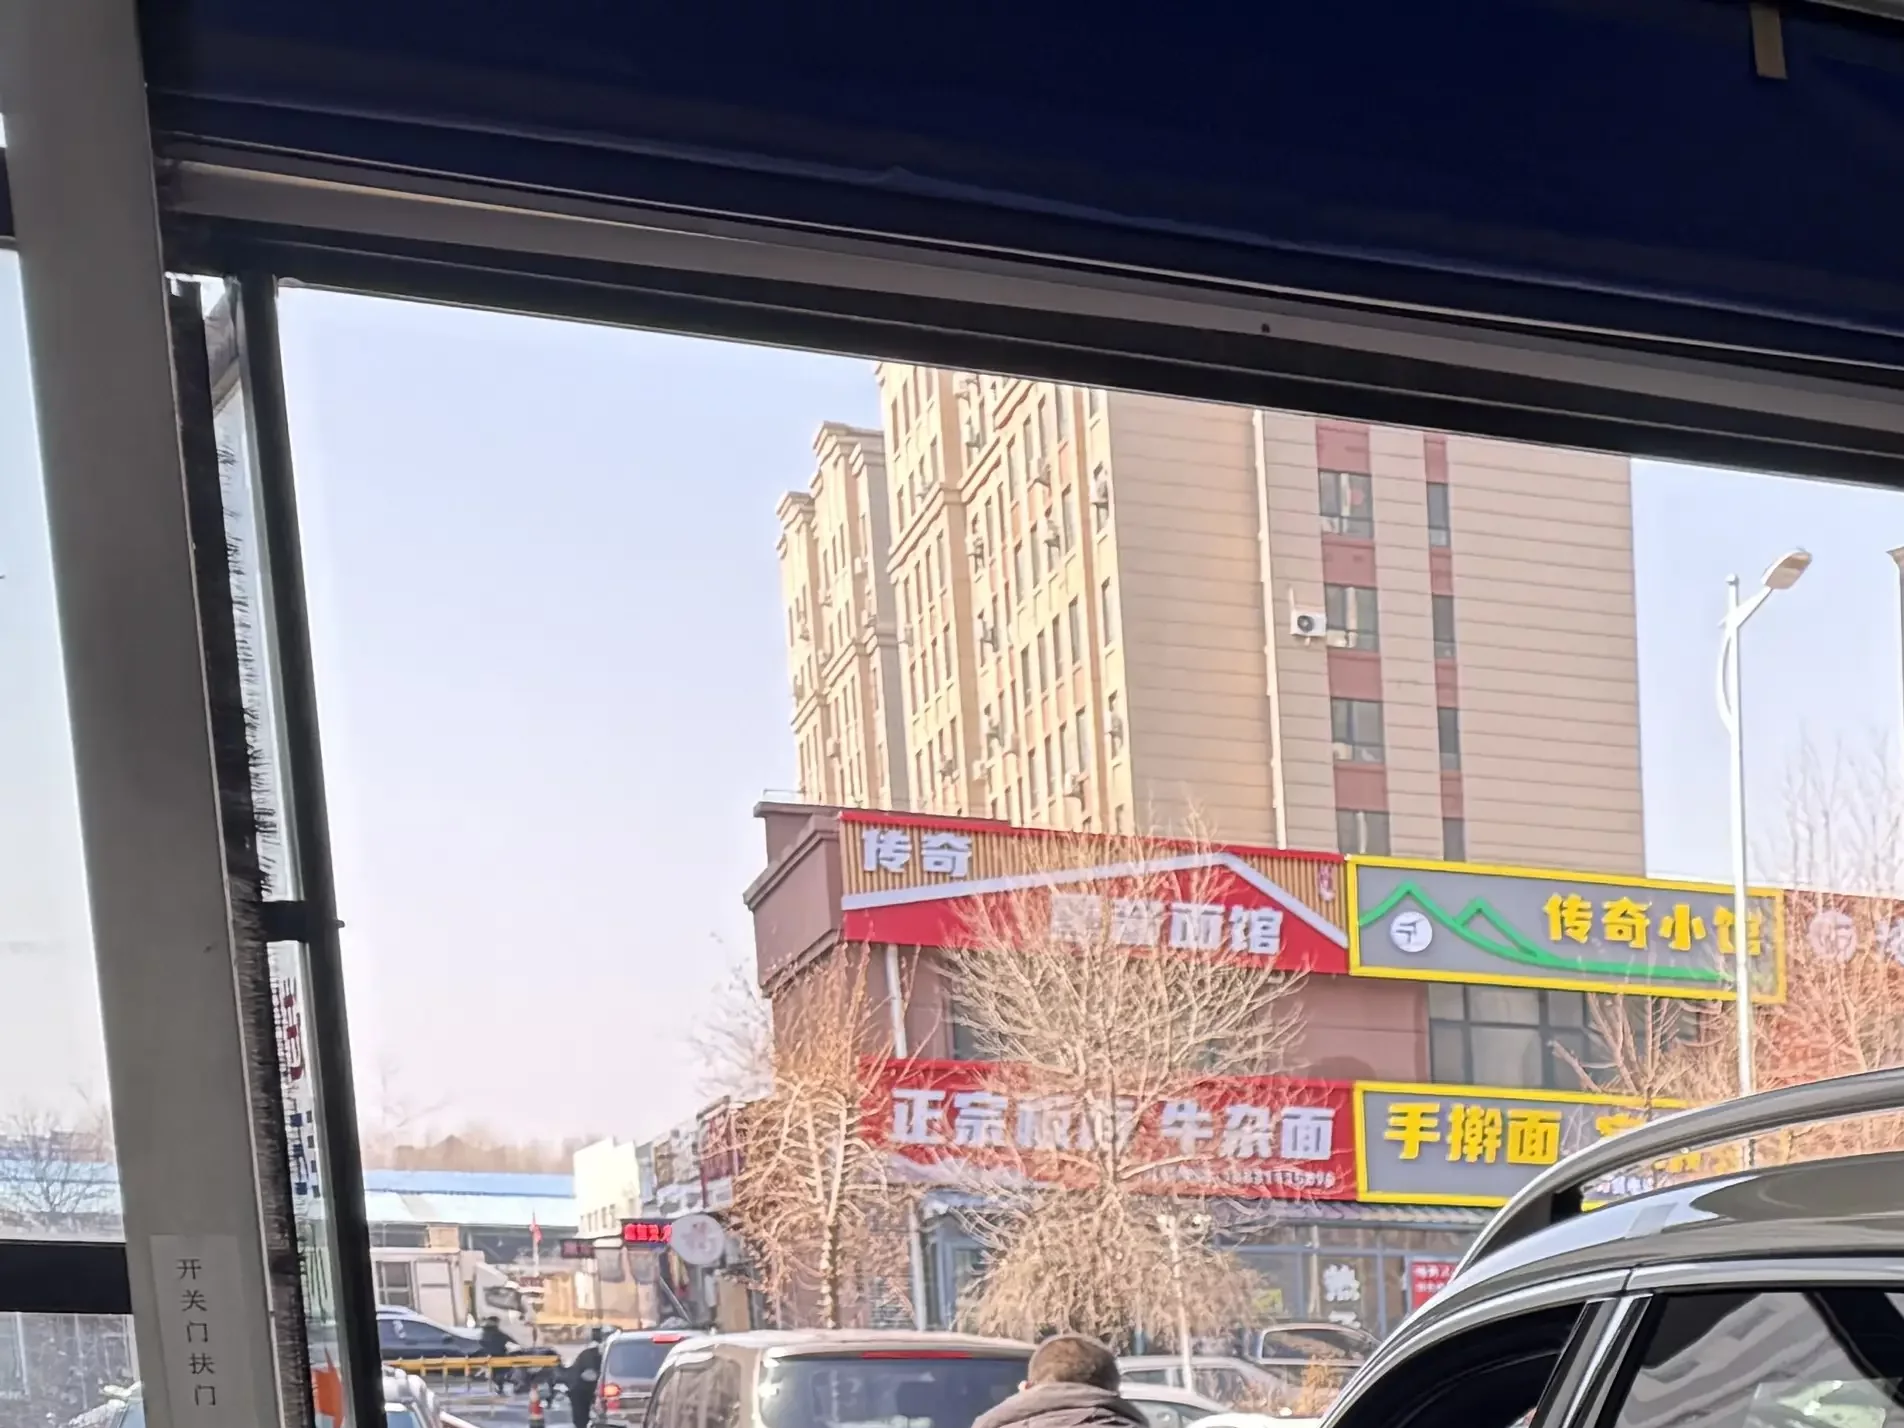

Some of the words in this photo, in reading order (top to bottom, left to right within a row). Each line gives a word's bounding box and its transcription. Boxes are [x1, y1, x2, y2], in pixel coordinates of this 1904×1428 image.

[861, 827, 973, 878] 传奇
[1543, 893, 1762, 956] 传奇小馆
[1163, 1102, 1336, 1160] 牛杂面
[1383, 1102, 1563, 1165] 手擀面
[176, 1258, 217, 1407] 开关门扶门
